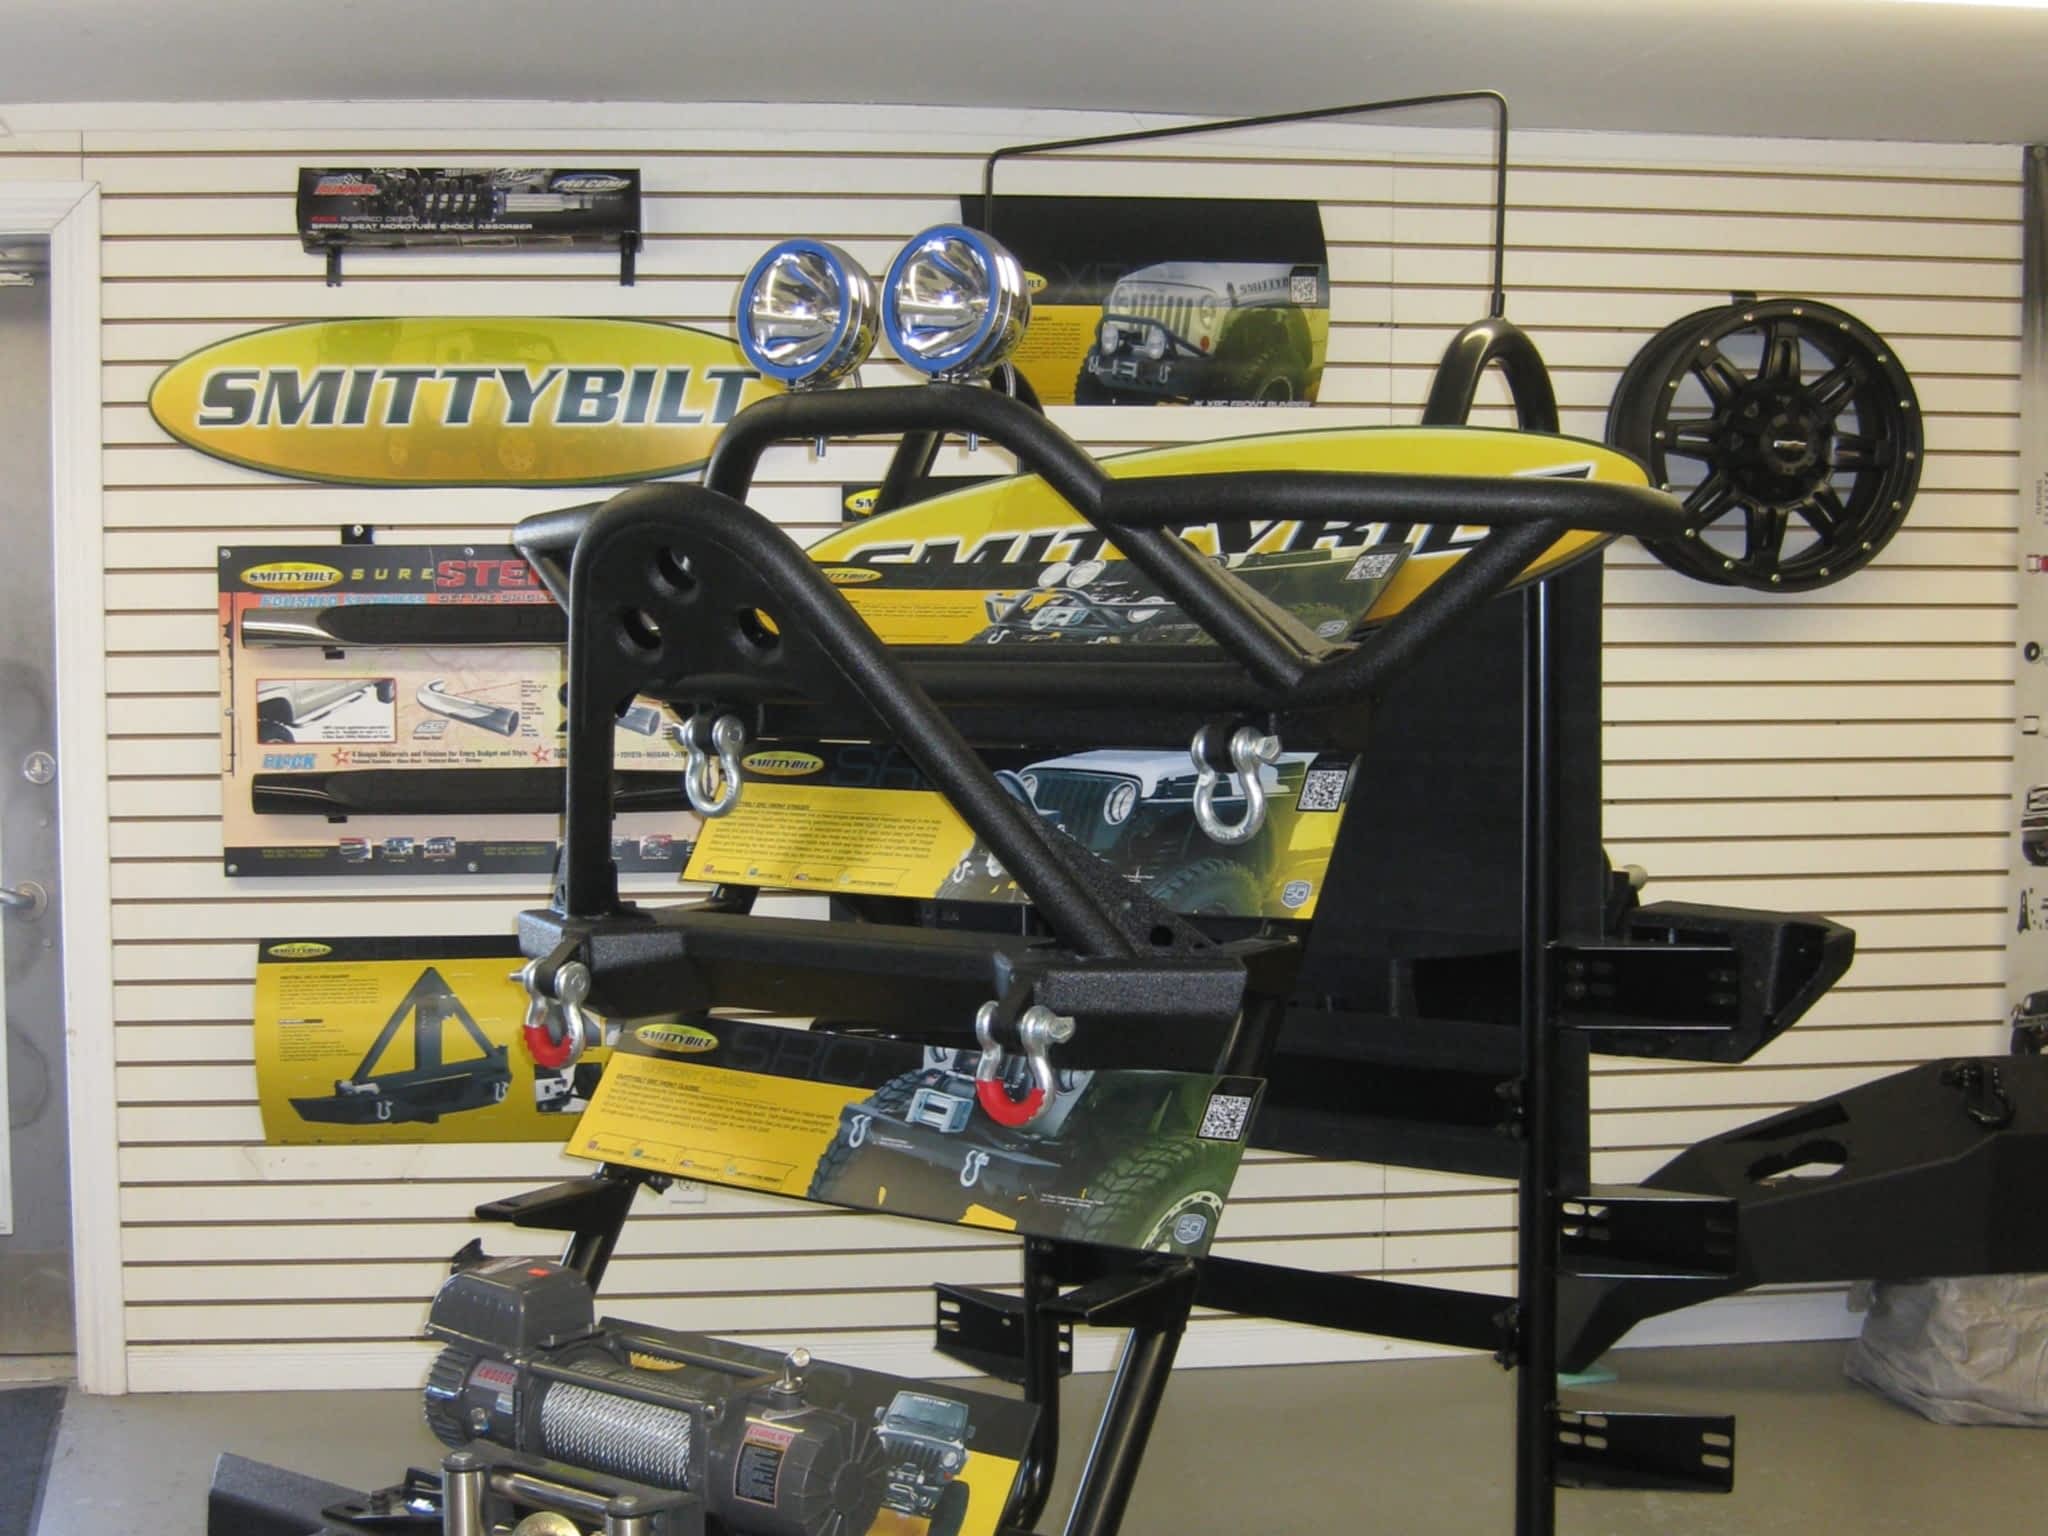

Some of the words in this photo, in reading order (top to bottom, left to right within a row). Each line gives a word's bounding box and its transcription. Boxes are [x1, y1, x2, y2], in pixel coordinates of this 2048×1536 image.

[197, 368, 763, 427] SMITTYBILT
[250, 571, 335, 582] SMITTYBILT
[351, 568, 434, 580] SURE
[436, 559, 541, 588] STE
[748, 758, 820, 769] SMITTYBILT
[641, 1029, 714, 1048] SMITTYBILT
